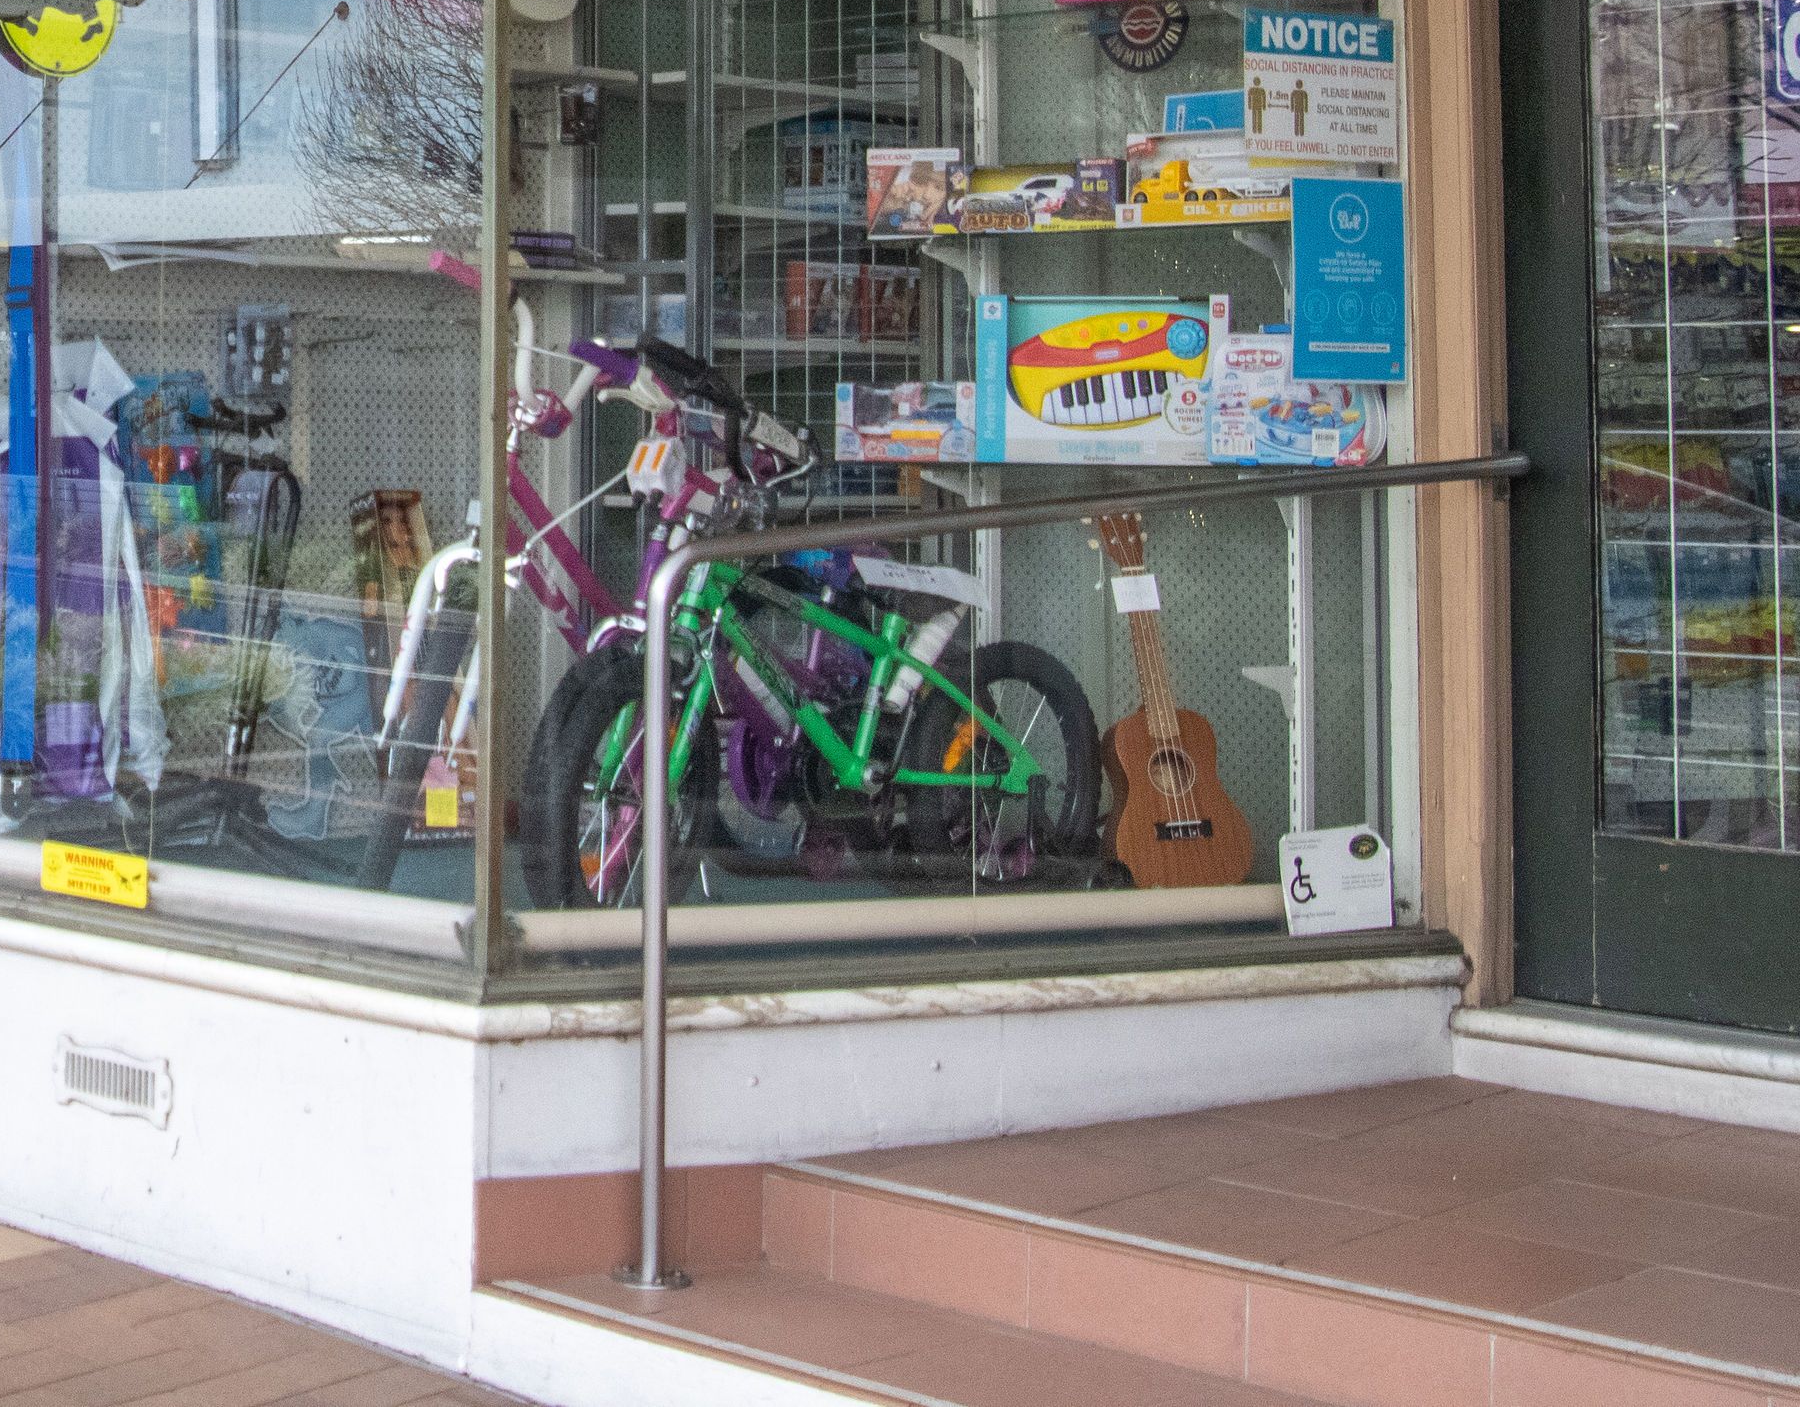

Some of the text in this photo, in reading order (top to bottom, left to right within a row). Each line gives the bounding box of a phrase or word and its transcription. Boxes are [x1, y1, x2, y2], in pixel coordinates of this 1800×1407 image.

[1261, 16, 1379, 56] NOTICE
[1244, 59, 1394, 80] SOCIAL DISTANCING IN PRACTICE
[1321, 87, 1386, 101] PLEASE MAINTAIN
[1317, 104, 1390, 119] SOCIAL DISTANCING
[1329, 122, 1378, 135] AT ALL TIMES
[1255, 139, 1272, 151] YOU
[1274, 140, 1294, 152] FEEL
[1296, 141, 1329, 155] UNWELL
[1337, 144, 1349, 155] DO
[1351, 145, 1366, 157] NOT
[1368, 146, 1394, 158] ENTER
[870, 153, 912, 163] MECCANO
[1185, 392, 1194, 404] 5
[64, 851, 115, 871] WARNING
